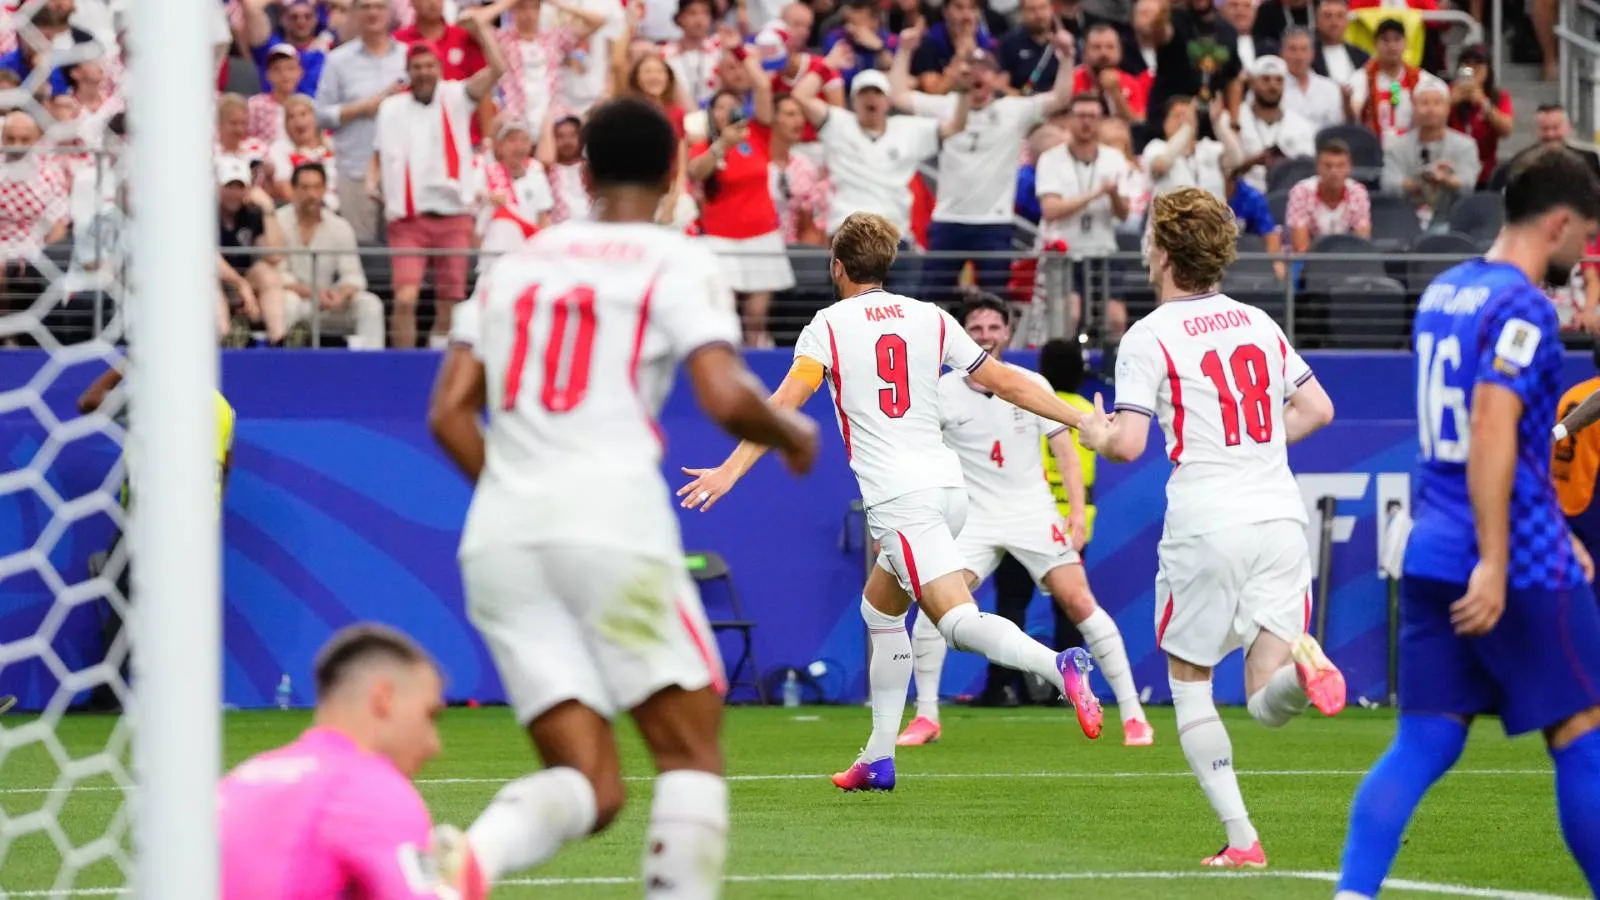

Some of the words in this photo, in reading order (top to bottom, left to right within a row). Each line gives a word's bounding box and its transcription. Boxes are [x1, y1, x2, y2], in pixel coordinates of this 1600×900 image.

[864, 304, 905, 321] KANE
[1183, 309, 1252, 337] GORDON
[502, 281, 598, 414] 10
[875, 333, 911, 418] 9
[1200, 343, 1273, 447] 18
[1416, 331, 1472, 463] 16
[989, 439, 1005, 469] 4
[1051, 523, 1067, 546] 4
